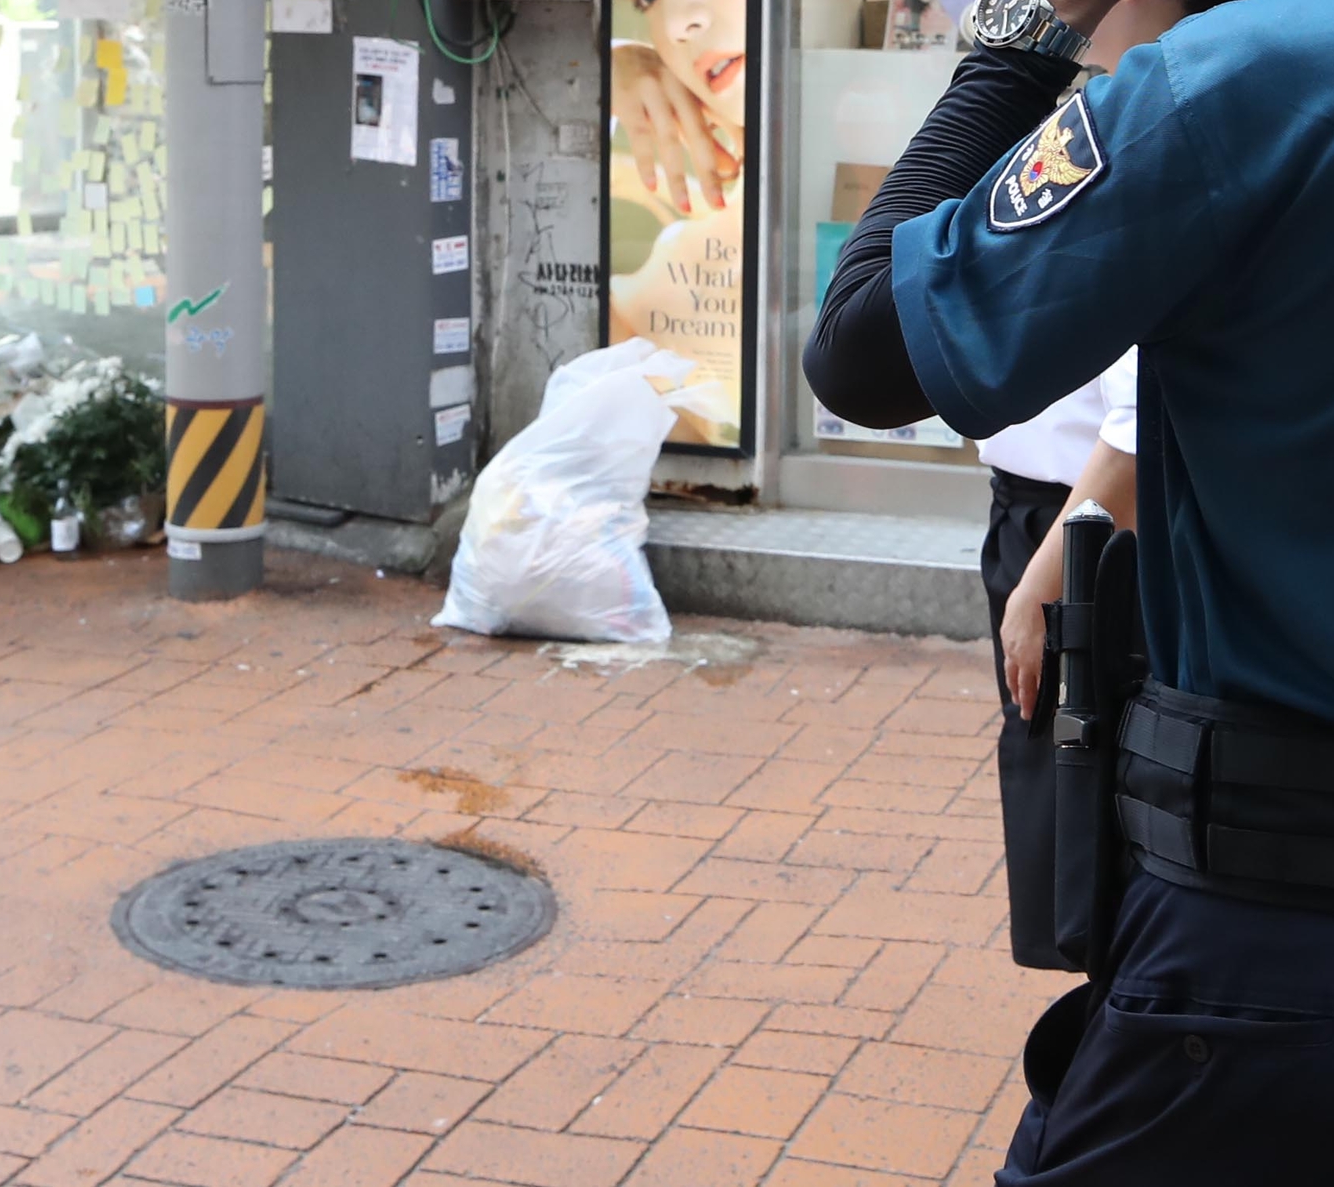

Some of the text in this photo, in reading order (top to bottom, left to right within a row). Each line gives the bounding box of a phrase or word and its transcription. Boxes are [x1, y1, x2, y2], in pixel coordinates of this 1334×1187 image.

[1004, 174, 1029, 217] POLICE
[705, 237, 737, 261] Be
[667, 261, 735, 288] What
[689, 288, 736, 314] You
[650, 310, 735, 338] Dream
